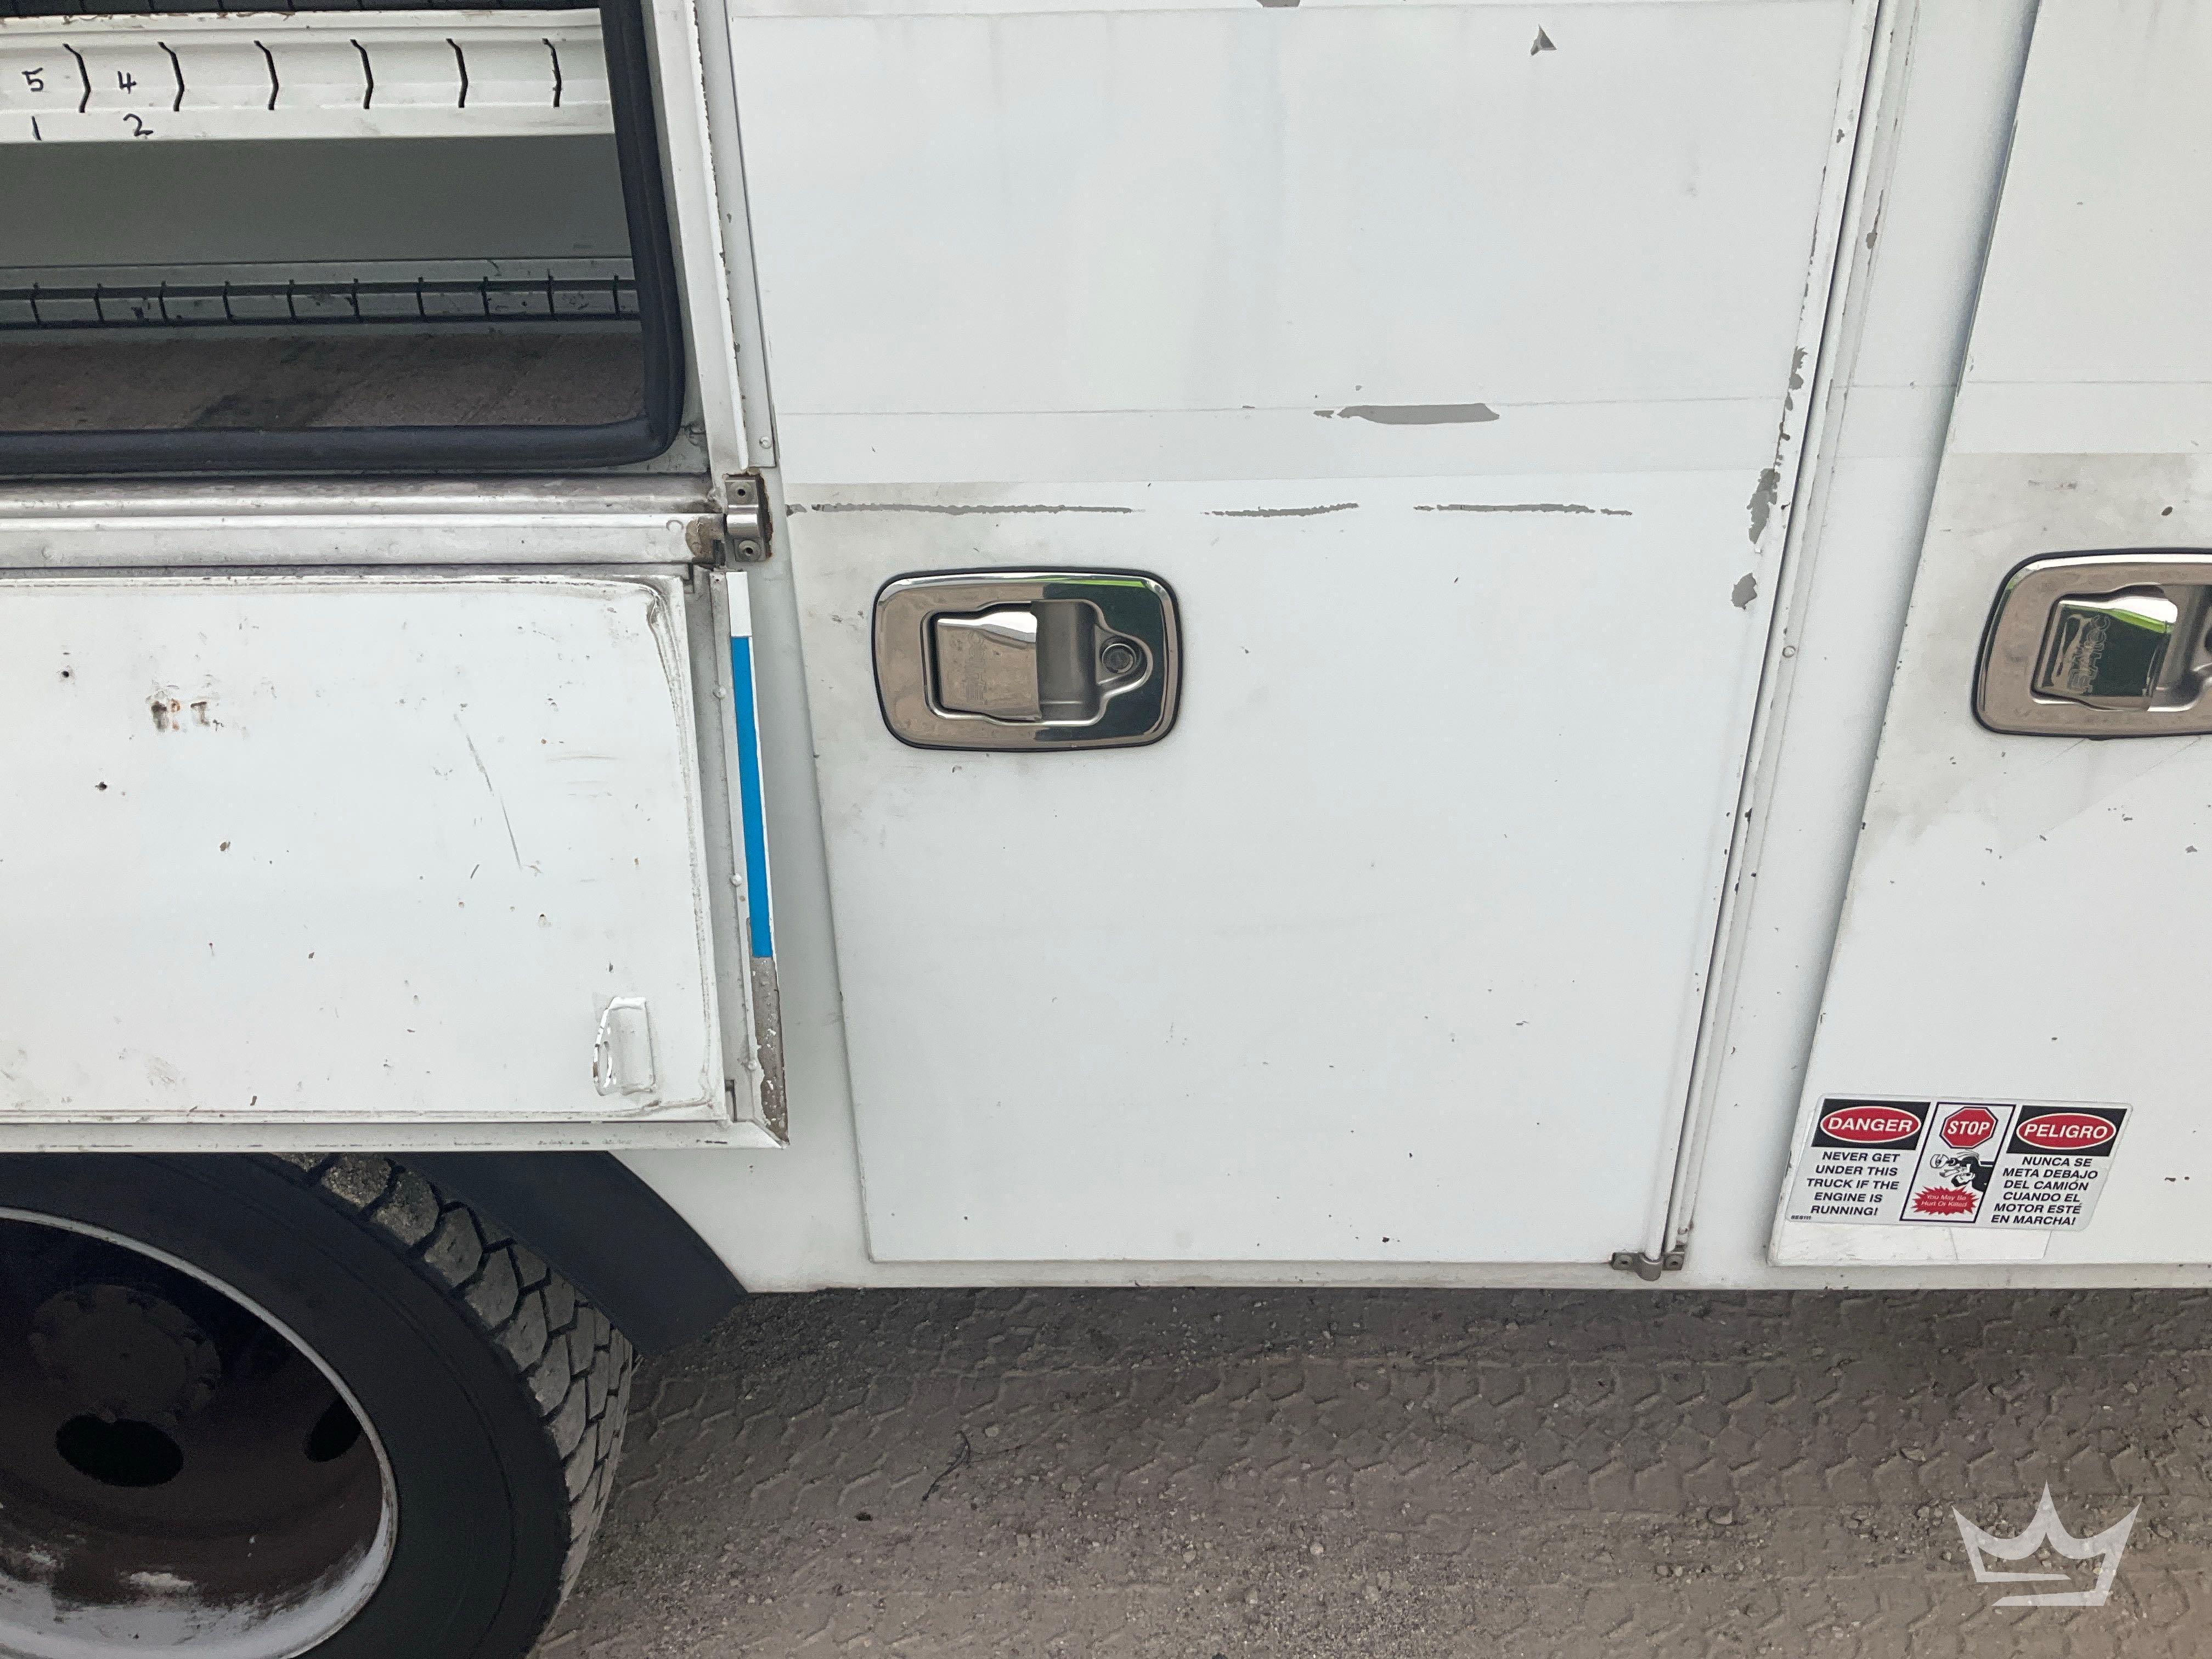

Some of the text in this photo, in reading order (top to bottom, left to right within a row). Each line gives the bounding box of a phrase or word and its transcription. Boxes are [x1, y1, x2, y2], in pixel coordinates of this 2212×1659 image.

[21, 67, 137, 94] 5 4
[31, 114, 154, 141] 1 2
[1828, 1117, 1913, 1132] DANGER
[1948, 1121, 1990, 1135] STOP
[2024, 1124, 2108, 1139] PELIGRO
[1822, 1152, 1900, 1163] NEVER GET
[2022, 1156, 2093, 1167] NUNCA SE
[1815, 1165, 1898, 1176] UNDER THIS
[2002, 1168, 2098, 1179] META DEBAJO
[1807, 1178, 1900, 1190] TRUCK IF THE
[2004, 1179, 2089, 1191] DEL CAMIÓN
[1814, 1192, 1883, 1203] ENGINE IS
[2003, 1192, 2080, 1203] CUANDO EL
[1810, 1205, 1878, 1216] RUNNING!
[1994, 1203, 2083, 1214] MOTOR ESTÉ
[1991, 1215, 2076, 1226] EN MARCHA!
